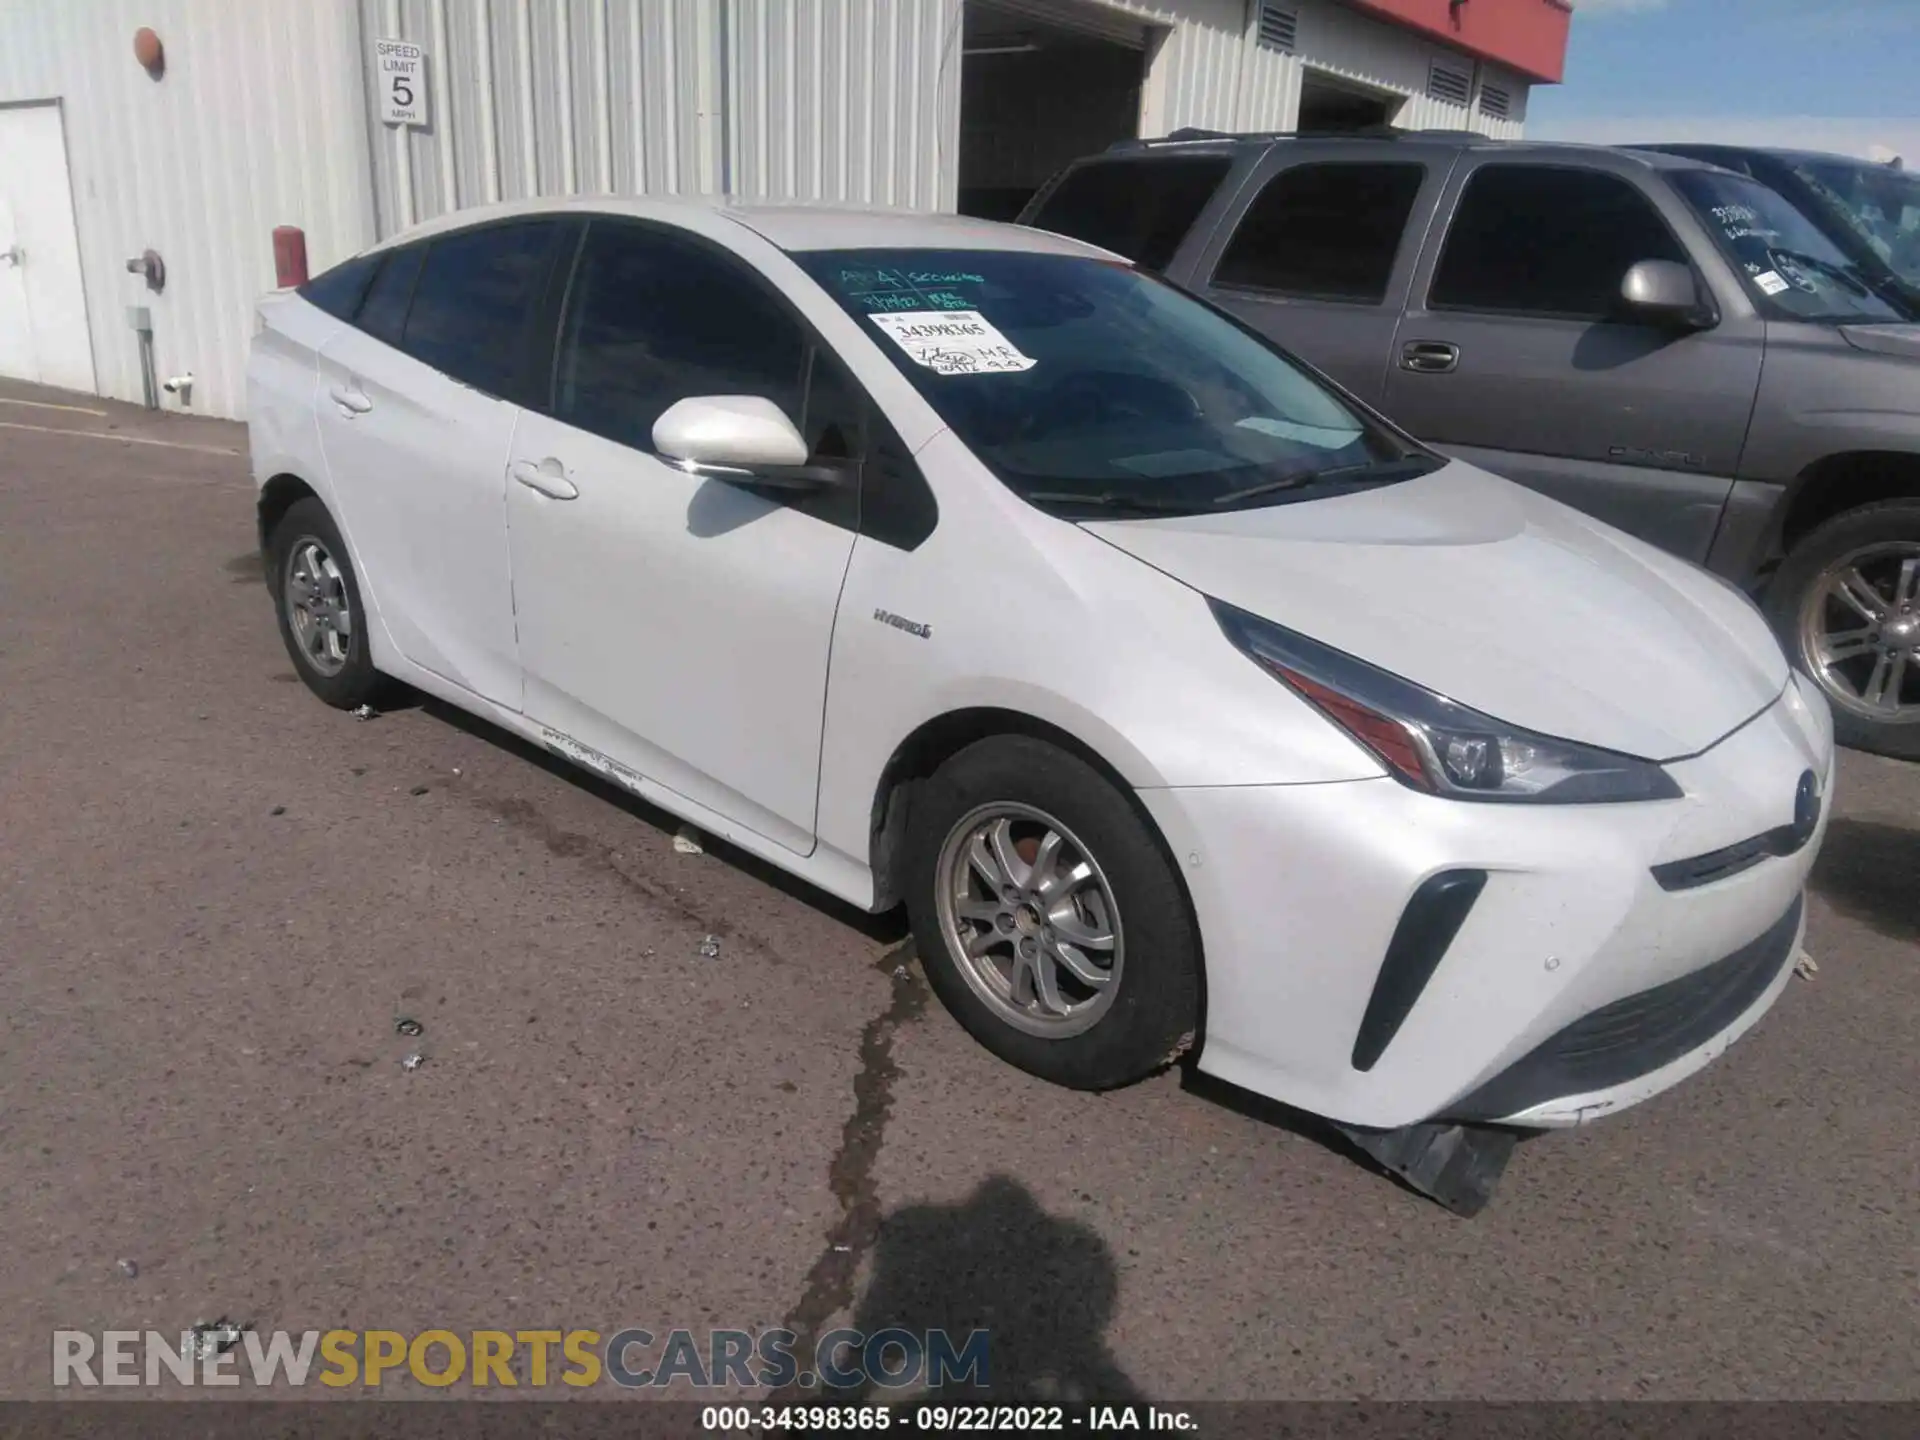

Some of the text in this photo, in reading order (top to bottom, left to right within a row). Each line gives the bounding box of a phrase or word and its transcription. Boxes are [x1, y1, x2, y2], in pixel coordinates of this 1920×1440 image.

[377, 42, 420, 59] SPEED
[383, 60, 417, 73] LIMIT
[391, 76, 414, 107] 5
[391, 108, 416, 119] MPH
[896, 323, 986, 338] 34398365
